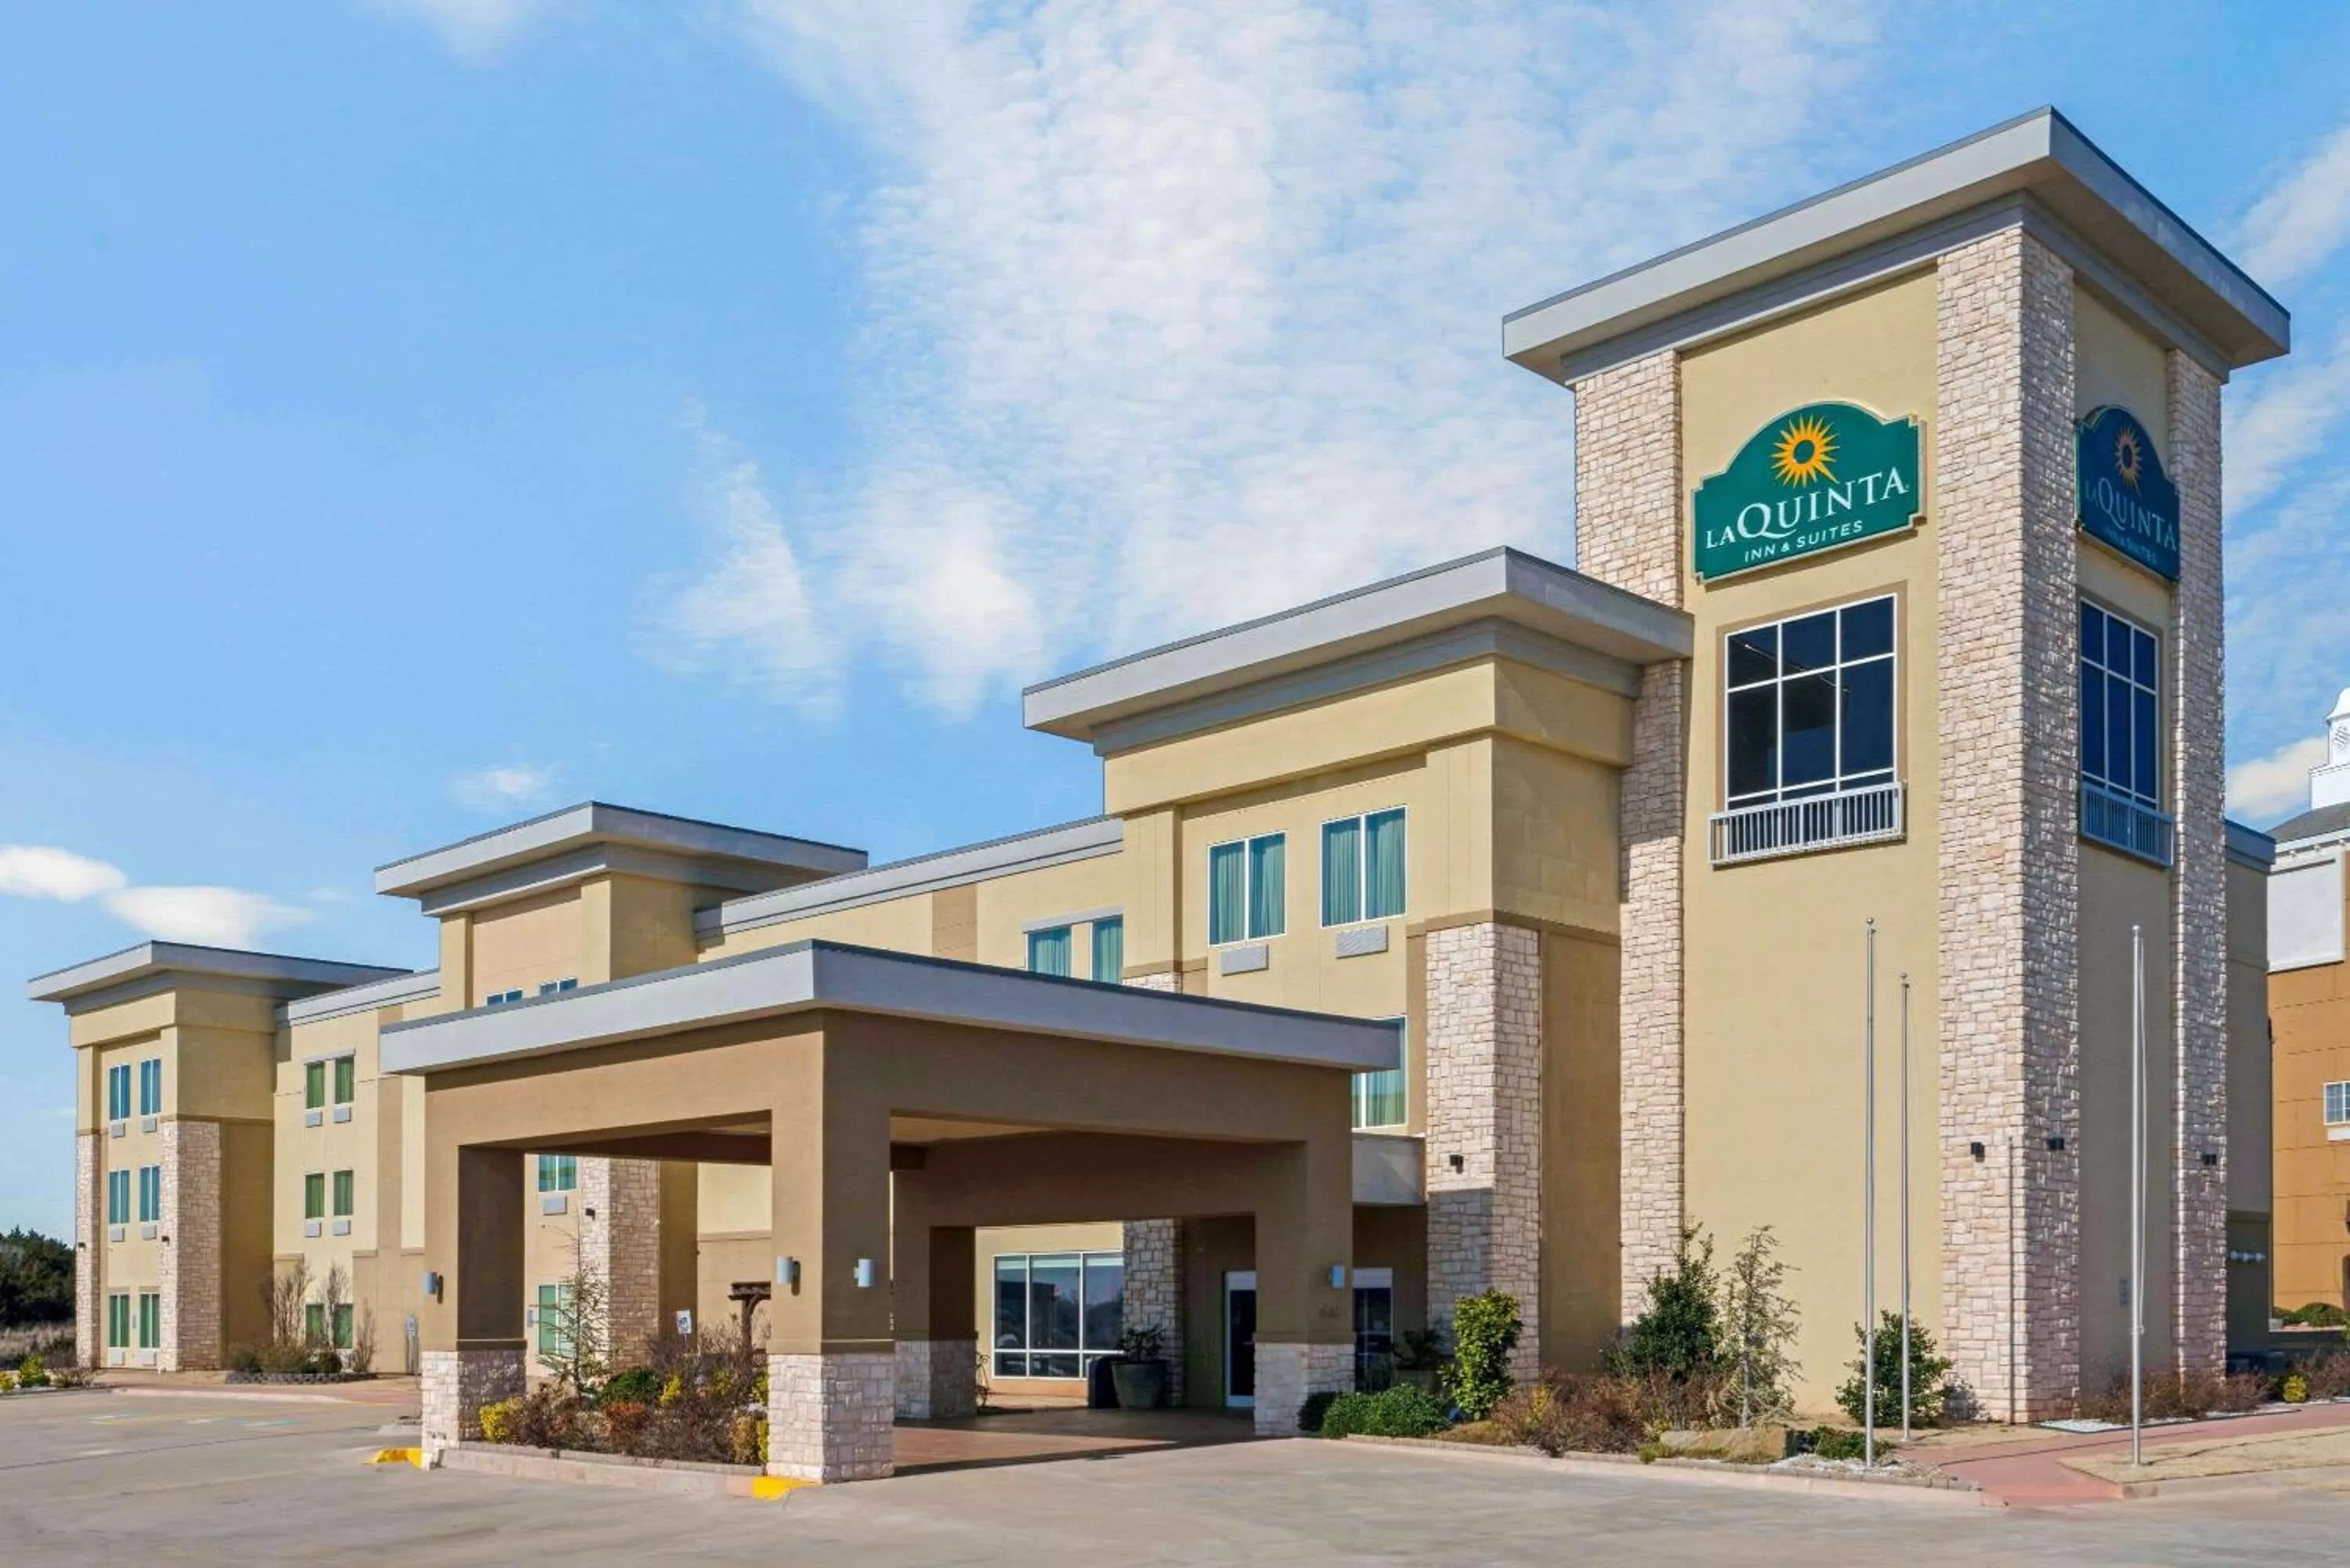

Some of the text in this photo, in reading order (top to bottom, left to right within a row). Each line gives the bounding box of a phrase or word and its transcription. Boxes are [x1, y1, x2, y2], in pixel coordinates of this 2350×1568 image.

[1705, 466, 1908, 549] LA QUINTA
[1744, 519, 1864, 563] INN & SUITES
[2098, 476, 2178, 552] QUINTA
